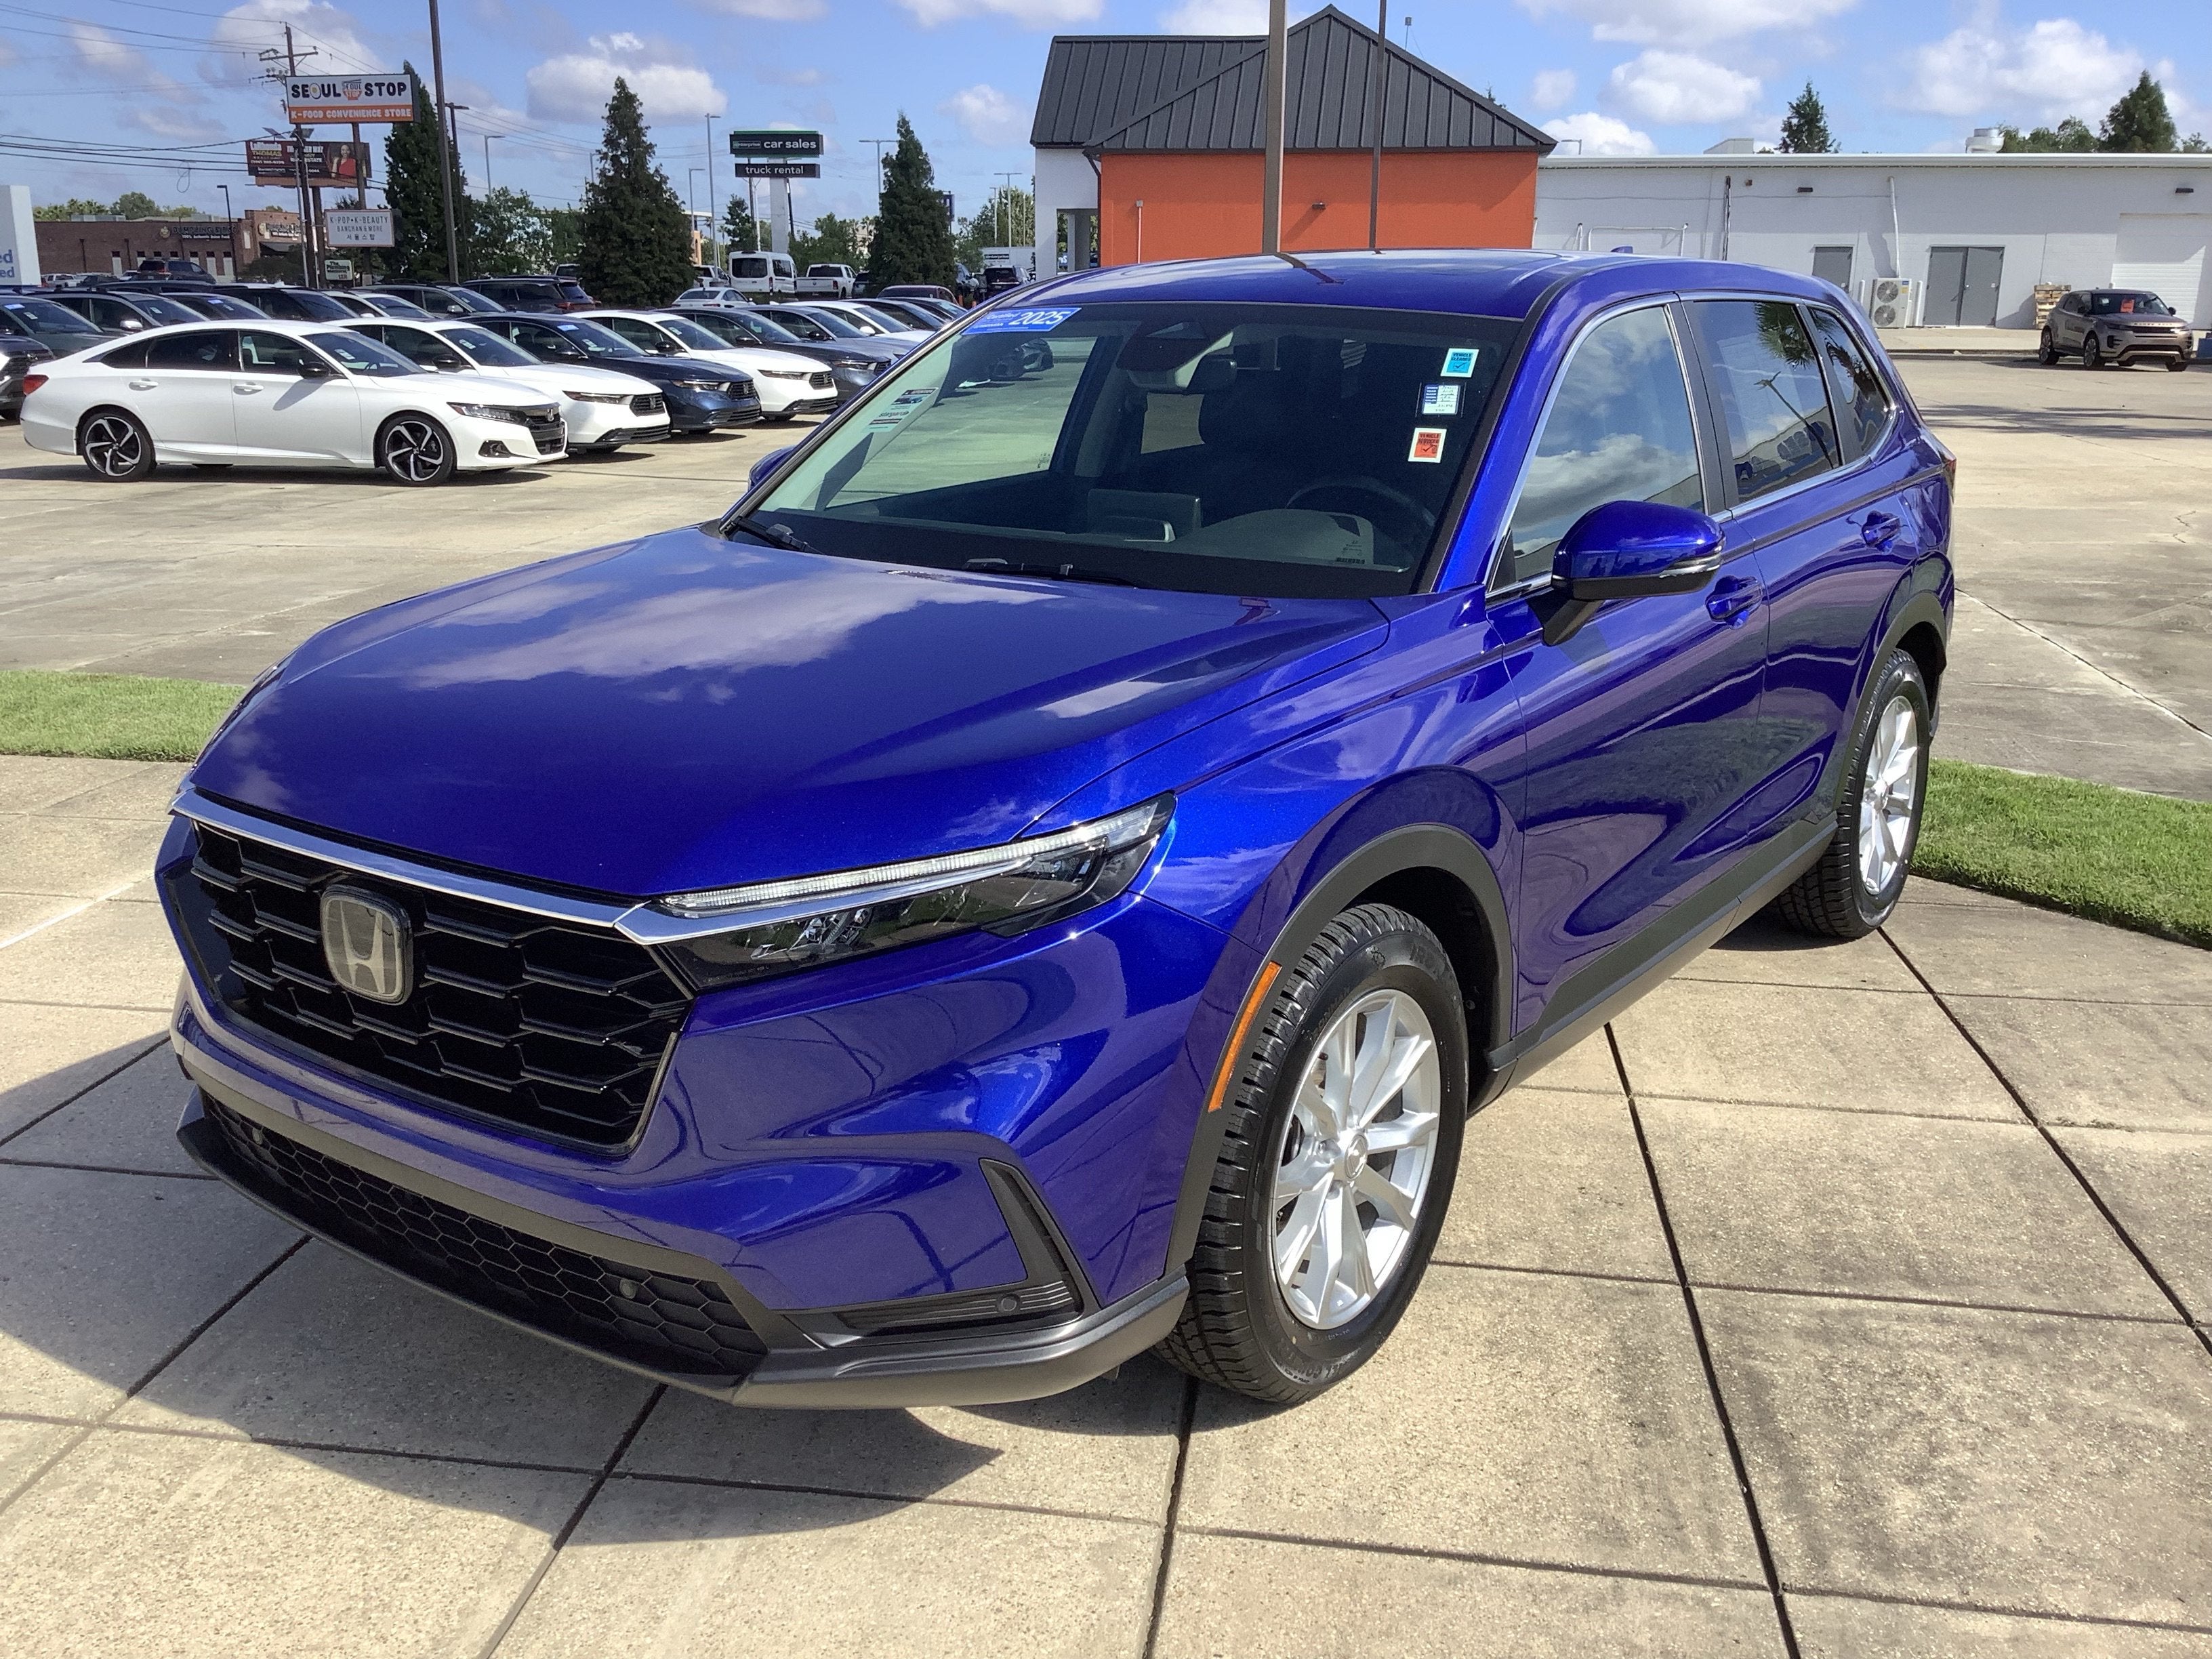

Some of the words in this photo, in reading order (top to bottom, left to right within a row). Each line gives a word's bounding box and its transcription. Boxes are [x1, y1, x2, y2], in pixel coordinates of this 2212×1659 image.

[291, 82, 342, 99] SEOUL
[365, 82, 407, 97] STOP
[291, 110, 323, 119] K-FOOD
[326, 109, 382, 118] CONVENIENCE
[384, 108, 411, 117] STORE
[785, 139, 817, 148] sales
[745, 165, 771, 174] truck
[775, 165, 804, 174] rental
[1008, 311, 1071, 326] 2025
